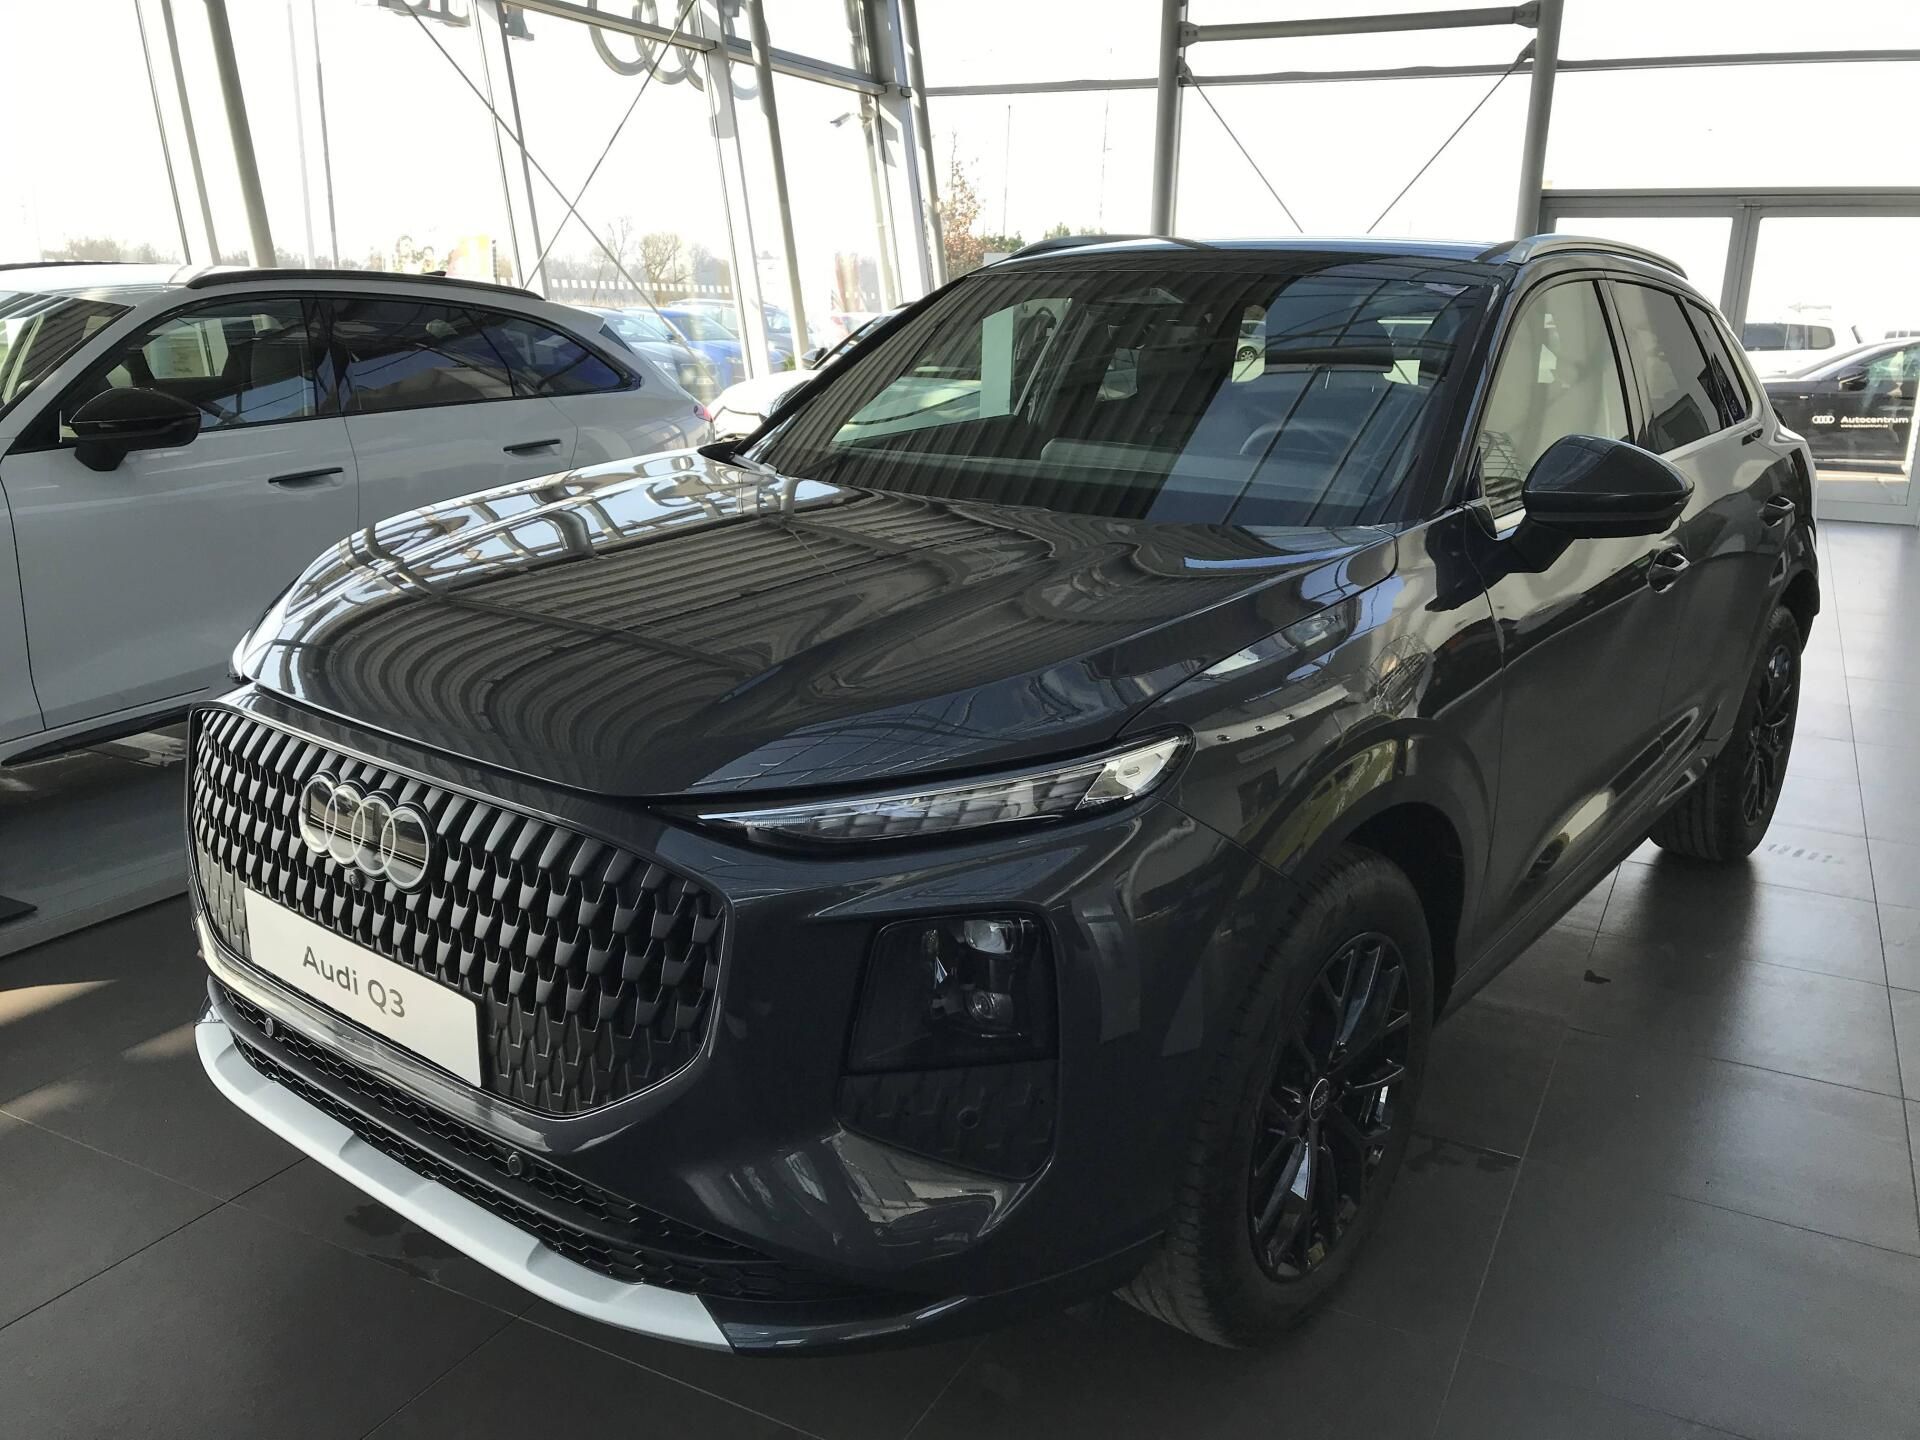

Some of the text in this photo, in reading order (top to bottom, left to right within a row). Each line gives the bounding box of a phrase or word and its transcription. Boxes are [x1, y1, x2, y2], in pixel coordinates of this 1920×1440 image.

[1840, 416, 1909, 424] Autocentrum
[303, 946, 405, 1018] Audi Q3
